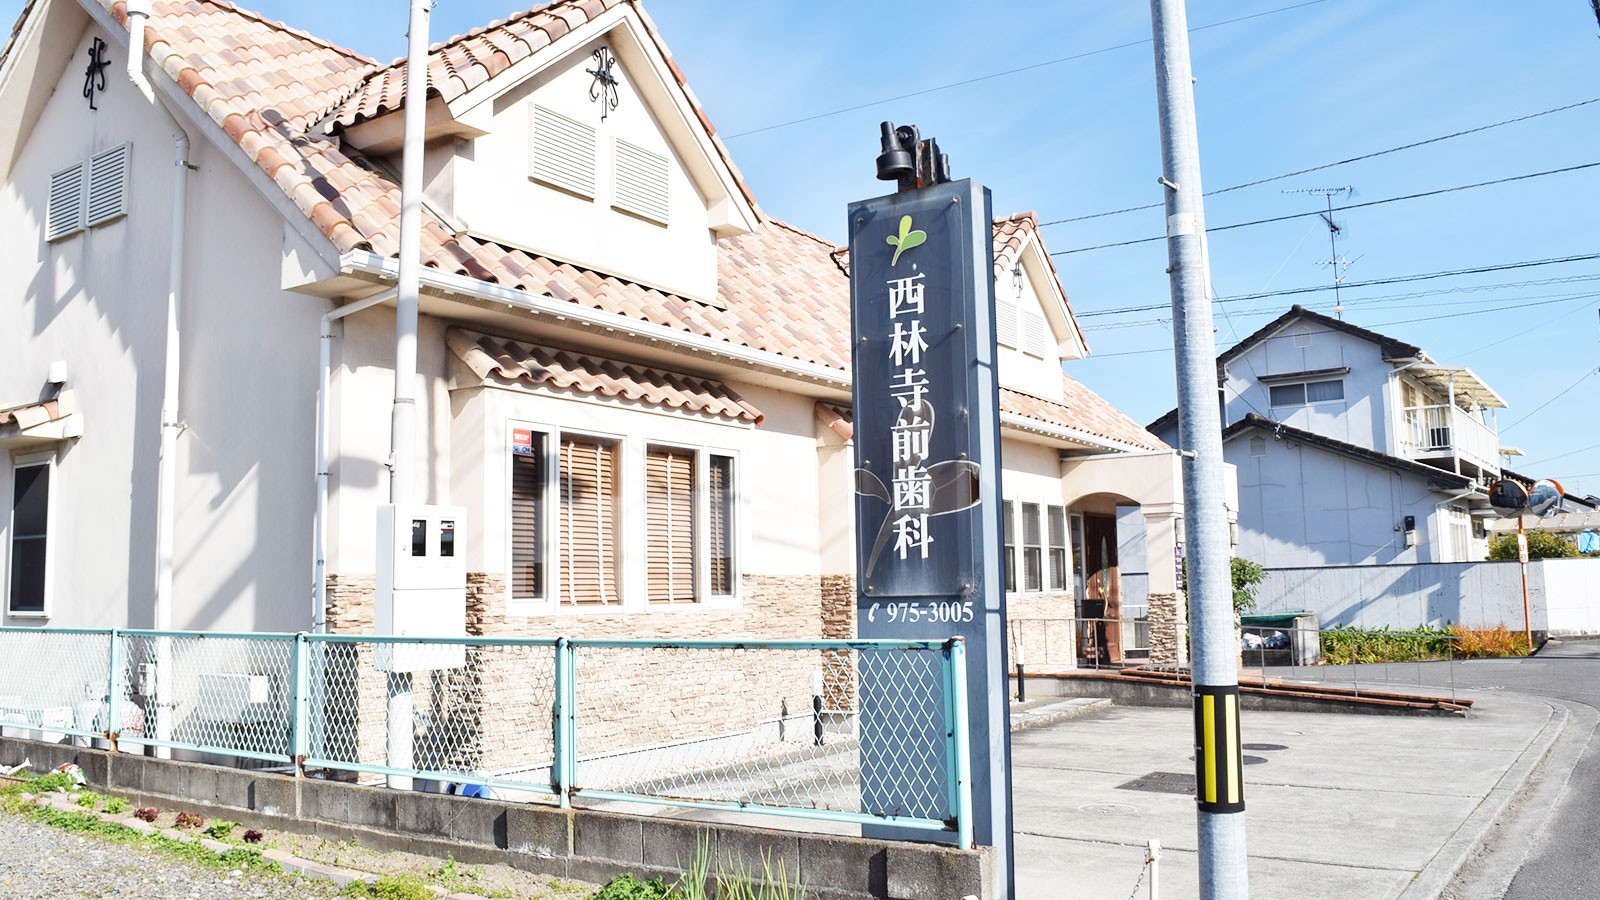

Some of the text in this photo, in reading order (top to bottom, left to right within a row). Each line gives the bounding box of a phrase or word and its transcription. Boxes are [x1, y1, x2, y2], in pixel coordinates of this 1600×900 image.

[886, 272, 935, 560] 西林寺前歯科
[886, 601, 974, 623] 975-3005
